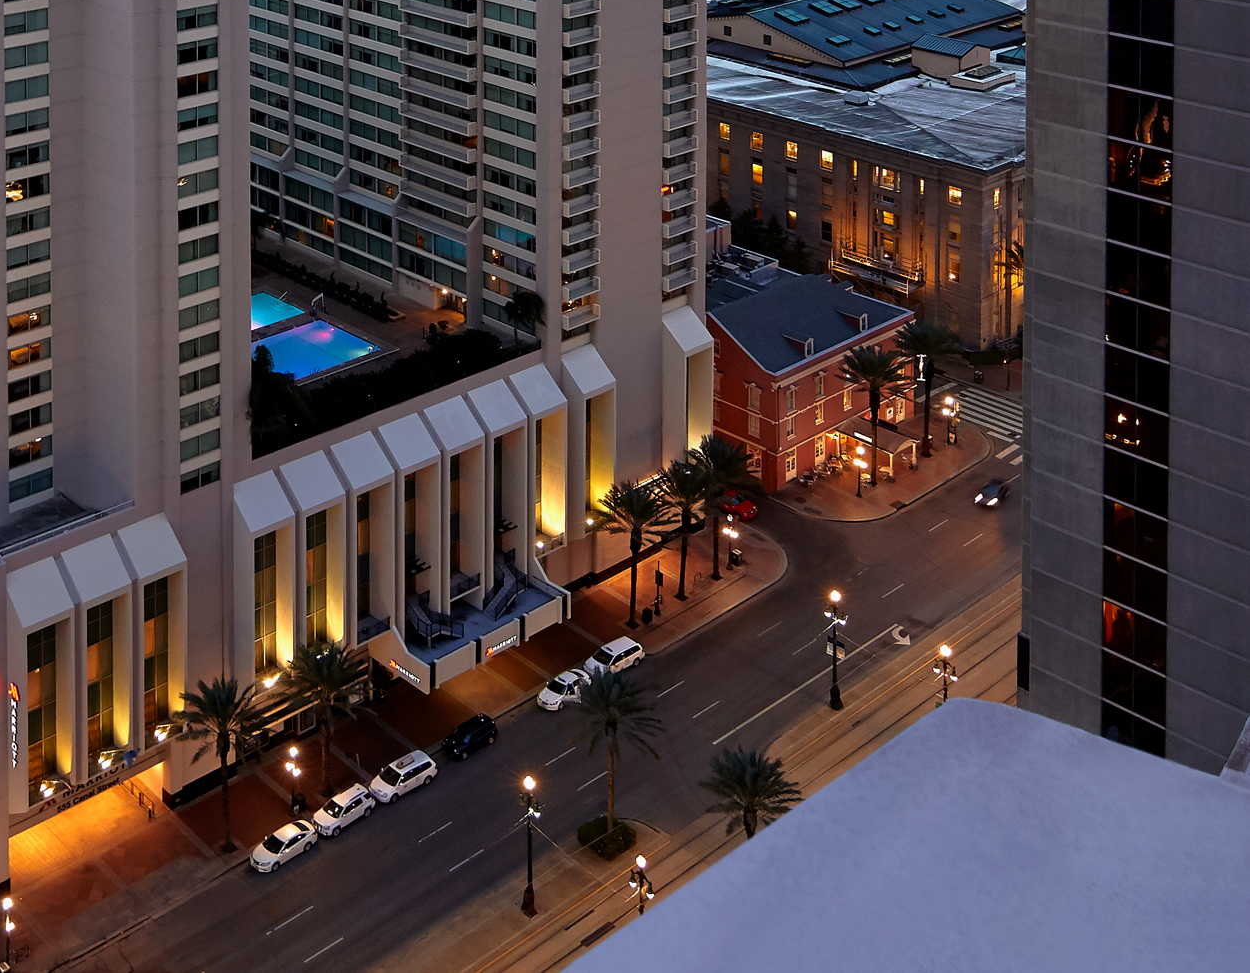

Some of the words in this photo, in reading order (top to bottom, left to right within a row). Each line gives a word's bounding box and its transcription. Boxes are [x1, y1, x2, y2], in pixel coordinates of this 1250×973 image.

[57, 801, 71, 813] 555
[73, 789, 95, 804] Canal
[96, 777, 120, 793] Street
